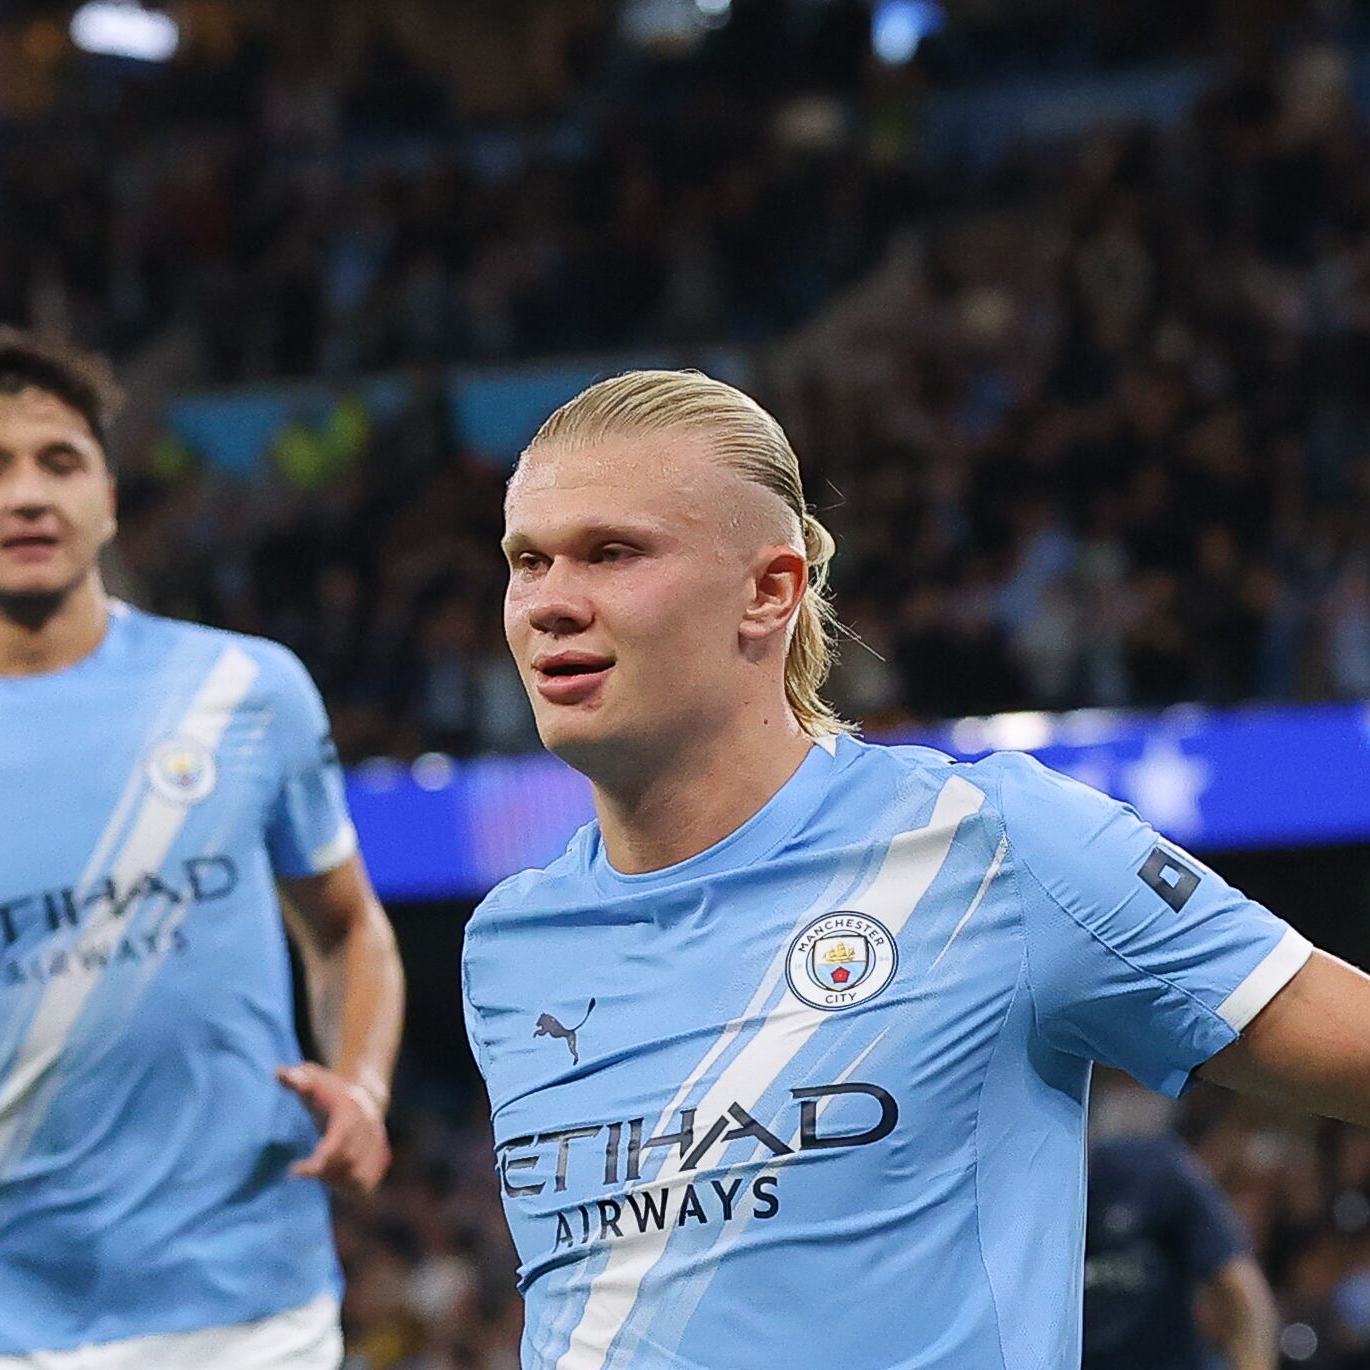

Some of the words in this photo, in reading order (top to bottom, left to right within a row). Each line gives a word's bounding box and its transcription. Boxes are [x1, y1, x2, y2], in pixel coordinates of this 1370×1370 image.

[798, 919, 885, 952] MANCHESTER
[825, 992, 857, 1004] CITY
[497, 1082, 899, 1197] ETIHAD
[550, 1177, 780, 1252] AIRWAYS
